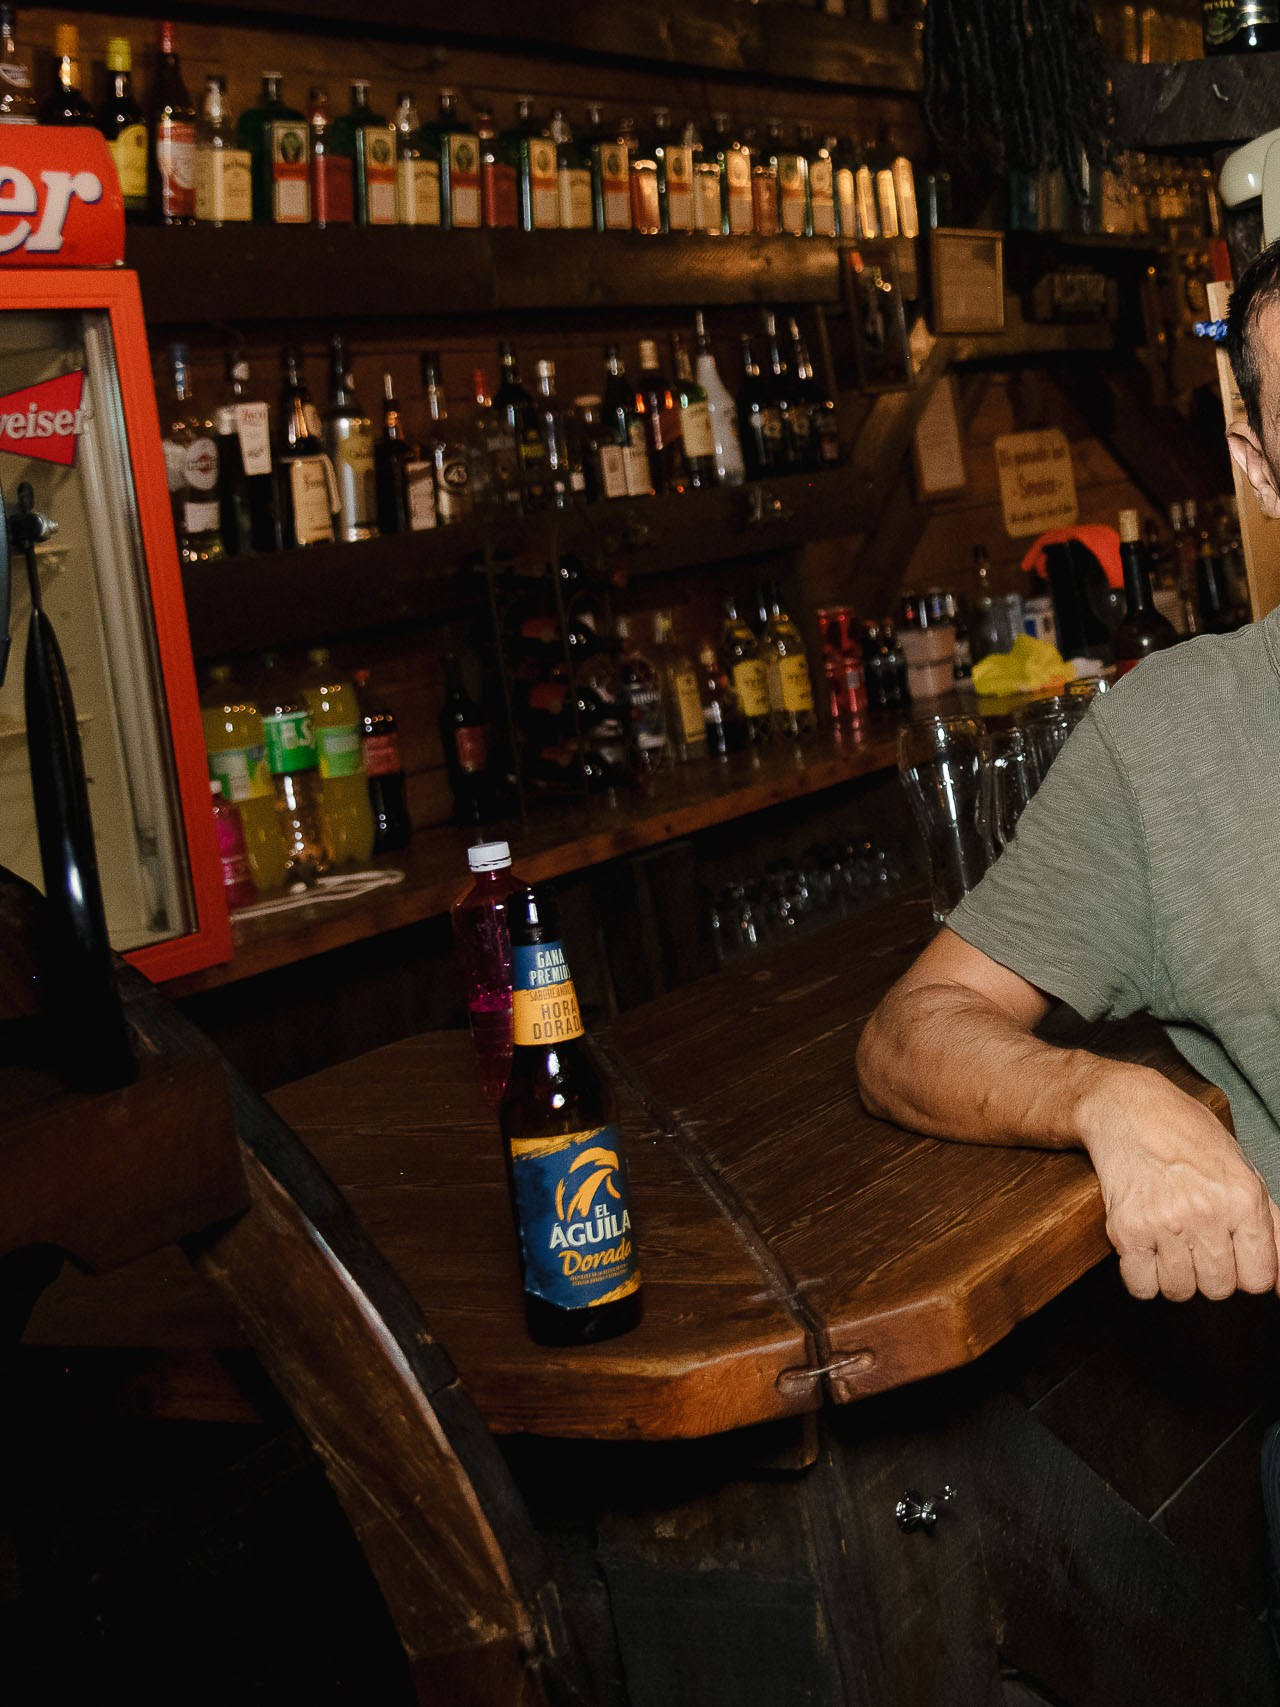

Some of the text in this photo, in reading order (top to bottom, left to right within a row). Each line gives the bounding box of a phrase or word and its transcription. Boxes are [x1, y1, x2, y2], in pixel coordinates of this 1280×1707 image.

[0, 401, 94, 440] eiser
[535, 948, 565, 969] GANA
[541, 998, 577, 1020] HORA
[595, 1203, 610, 1219] EL
[549, 1209, 631, 1249] ÁGUILA
